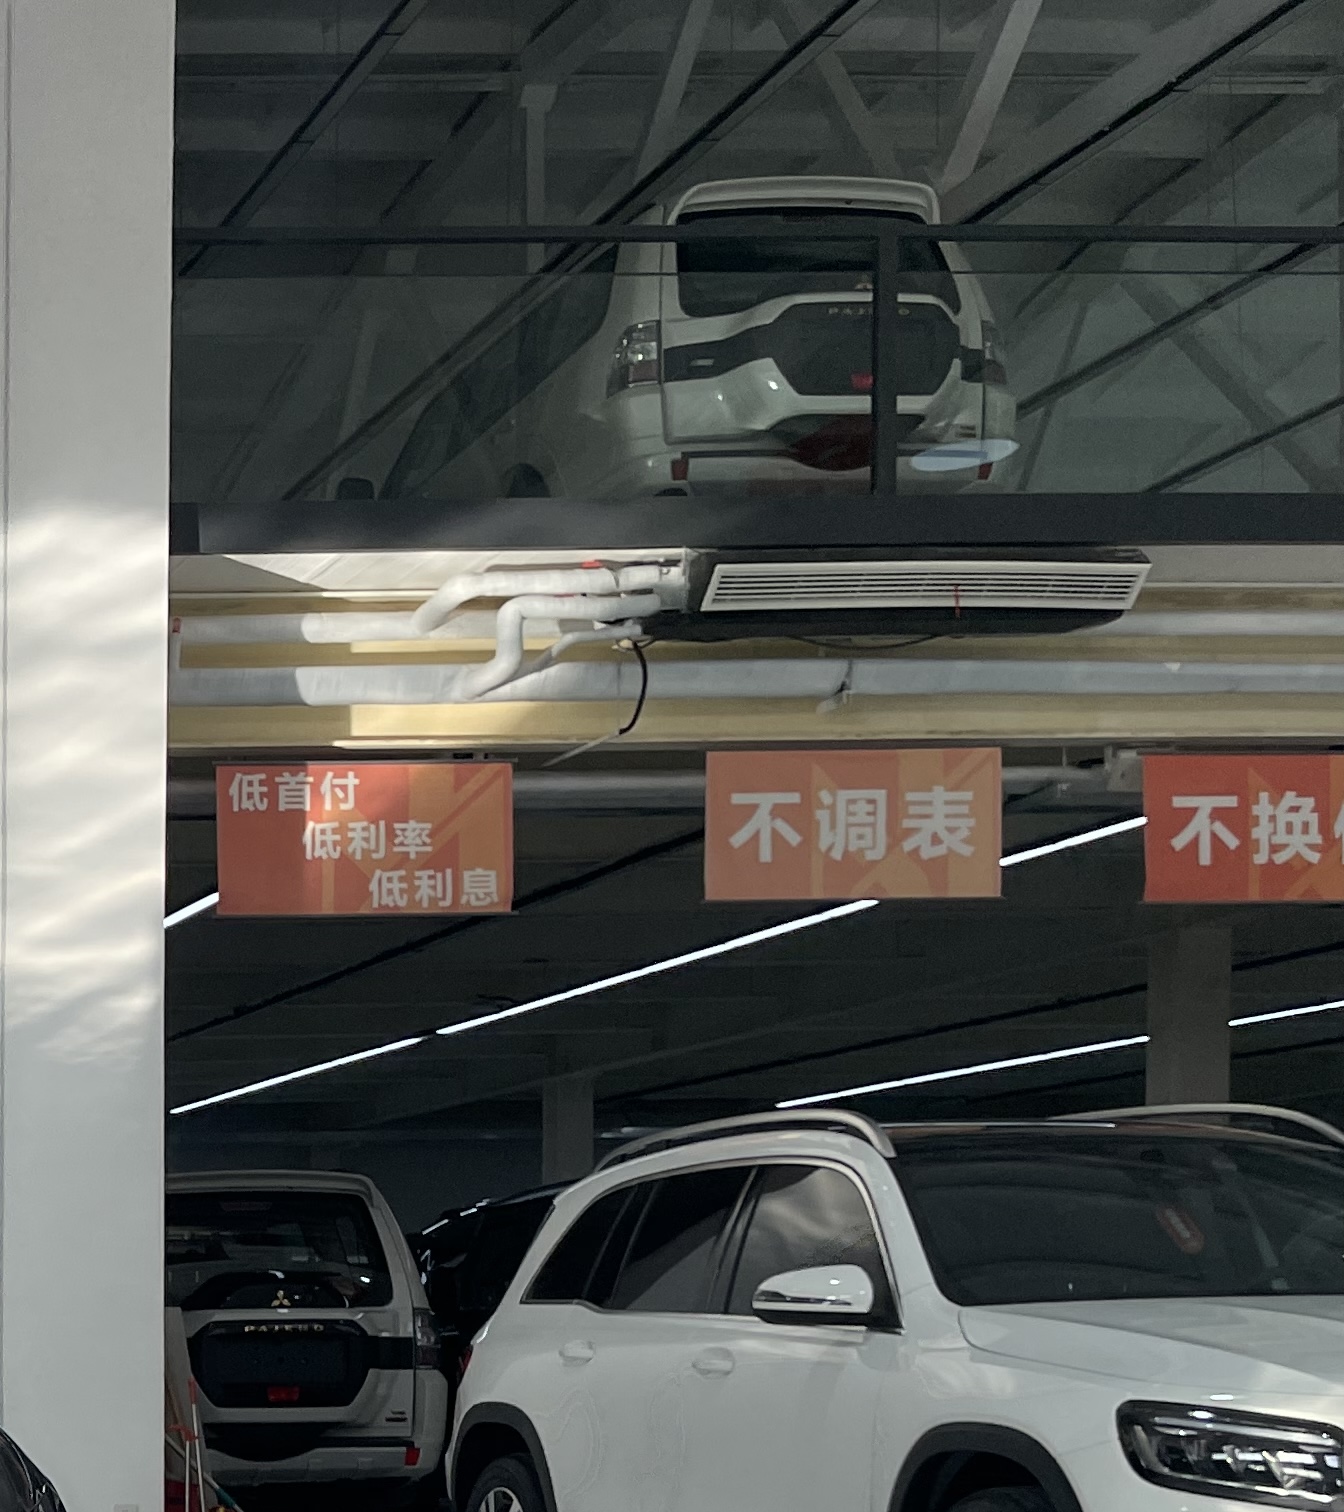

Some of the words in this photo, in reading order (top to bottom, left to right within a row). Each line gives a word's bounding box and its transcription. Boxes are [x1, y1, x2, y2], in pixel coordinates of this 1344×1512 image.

[229, 771, 360, 812] 低首付
[302, 820, 433, 860] 低利率
[728, 786, 976, 863] 不调表
[1171, 791, 1344, 866] 不换
[369, 868, 499, 909] 低利息
